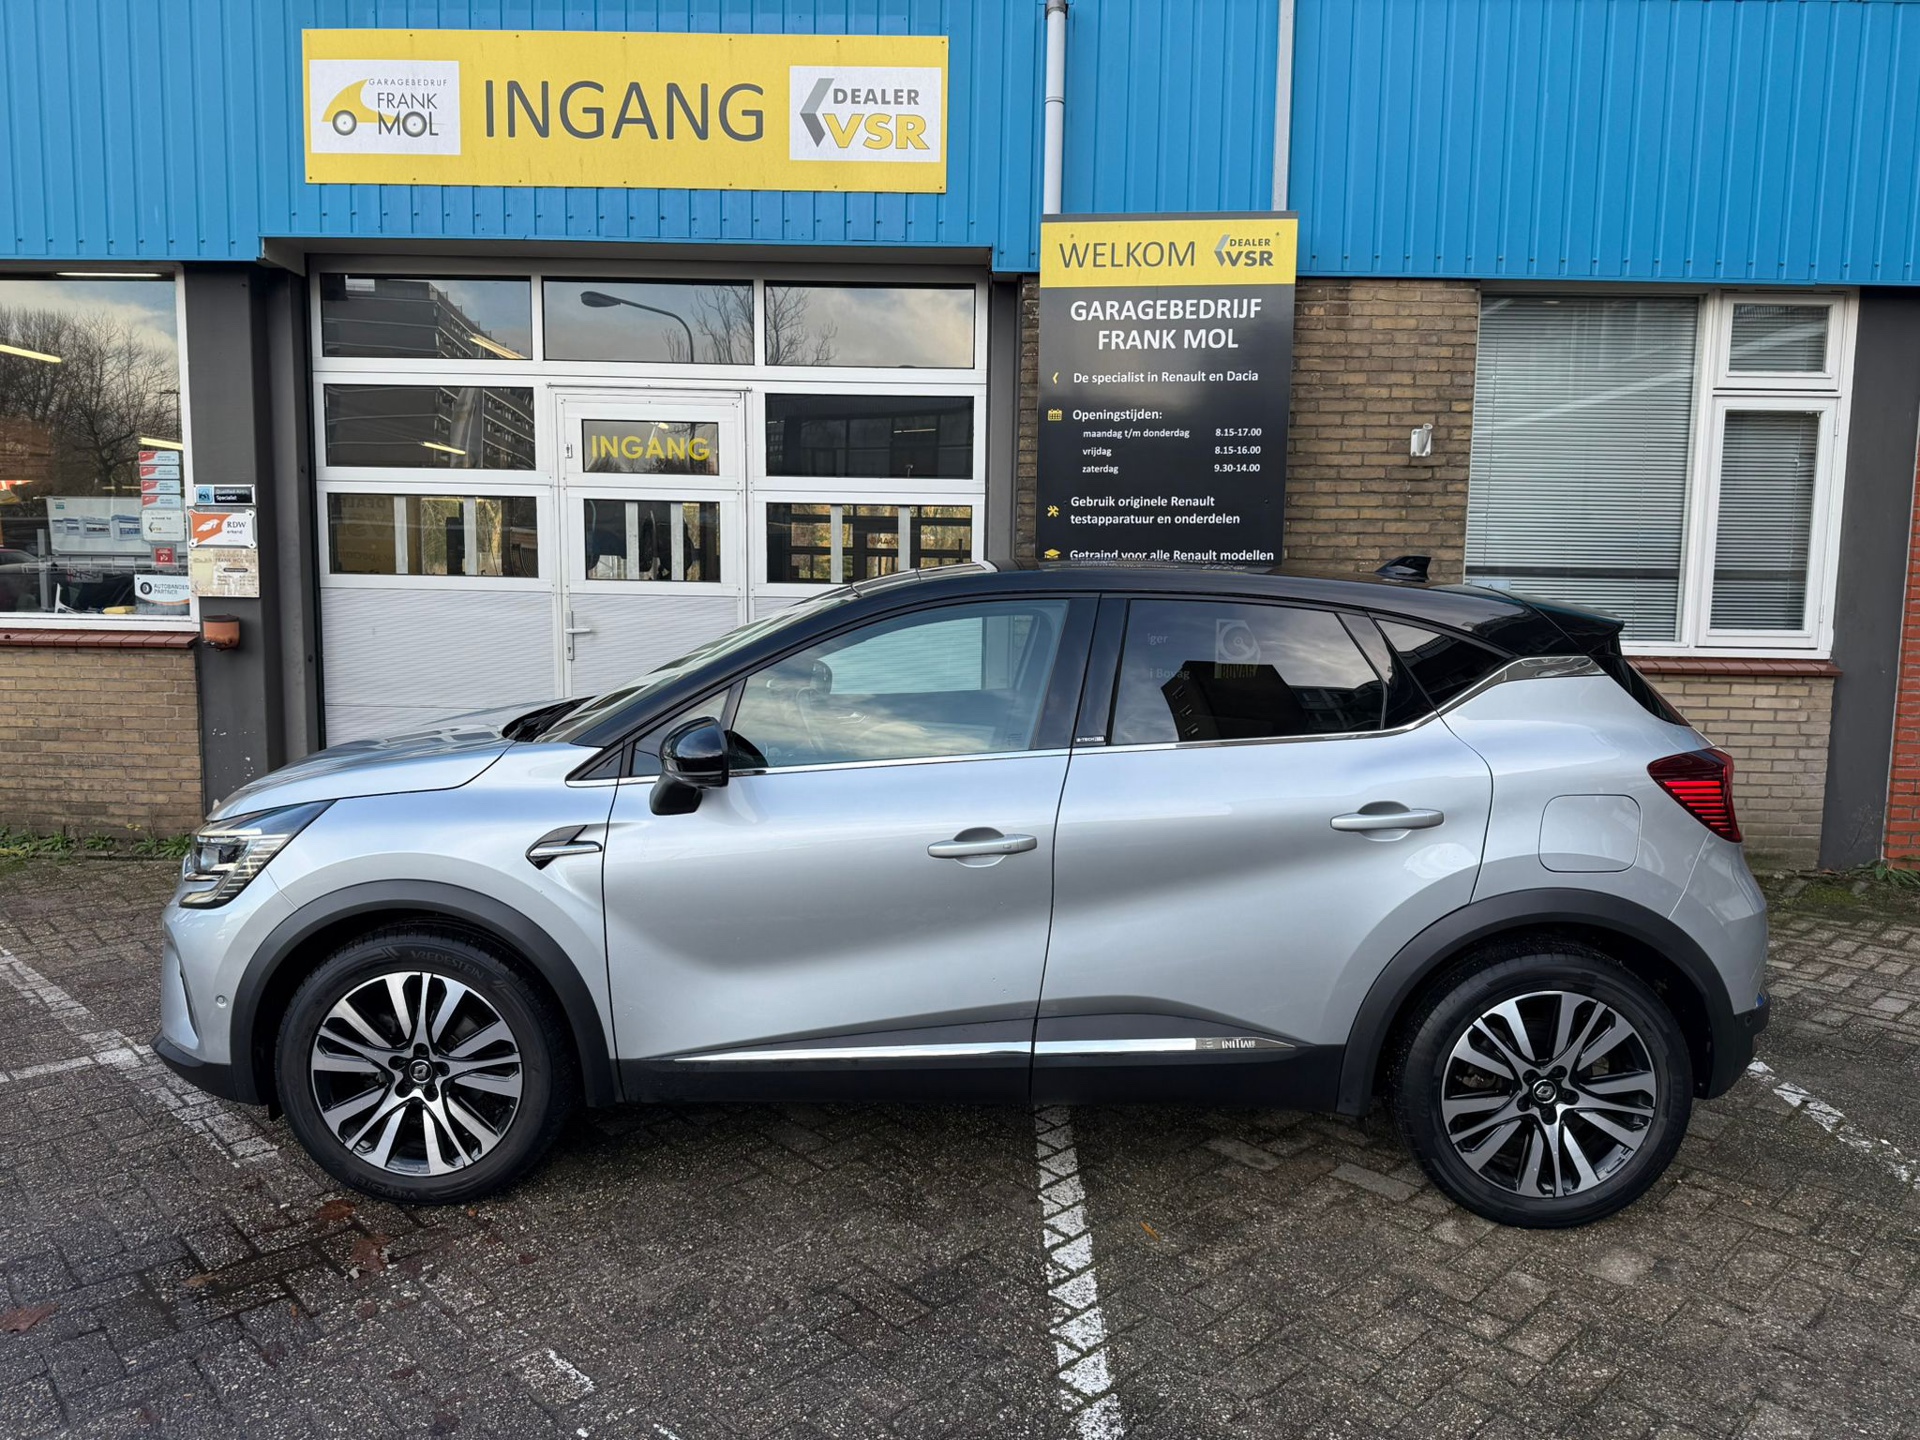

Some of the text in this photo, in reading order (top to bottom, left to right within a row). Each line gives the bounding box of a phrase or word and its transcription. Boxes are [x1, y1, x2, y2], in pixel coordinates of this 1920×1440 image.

[368, 78, 448, 87] GARAGEBEDRIJF
[377, 92, 438, 109] FRANK
[833, 87, 920, 106] DEALER
[484, 79, 765, 142] INGANG
[377, 110, 439, 138] MOL
[822, 112, 930, 150] VSR
[1229, 238, 1271, 247] DEALER
[1059, 241, 1195, 268] WELKOM
[1225, 250, 1274, 267] VSR
[1070, 298, 1262, 322] GARAGEBEDRIJF
[1098, 328, 1239, 350] FRANK MOL
[1073, 370, 1259, 387] De specialist in Renault en Dacia
[1072, 409, 1163, 422] Openingstijden:
[1083, 428, 1262, 439] maandag t/m donderdag 8.15-17.00
[591, 435, 710, 461] INGANG
[1082, 446, 1261, 457] vrijdag 8.15-16.00
[1082, 464, 1260, 475] zaterdag 9.30-14.00
[1071, 496, 1215, 510] Gebruik originele Renault
[1070, 514, 1240, 526] testapparatuur en onderdelen
[1069, 550, 1274, 561] Getraind voor alle Renault modellen
